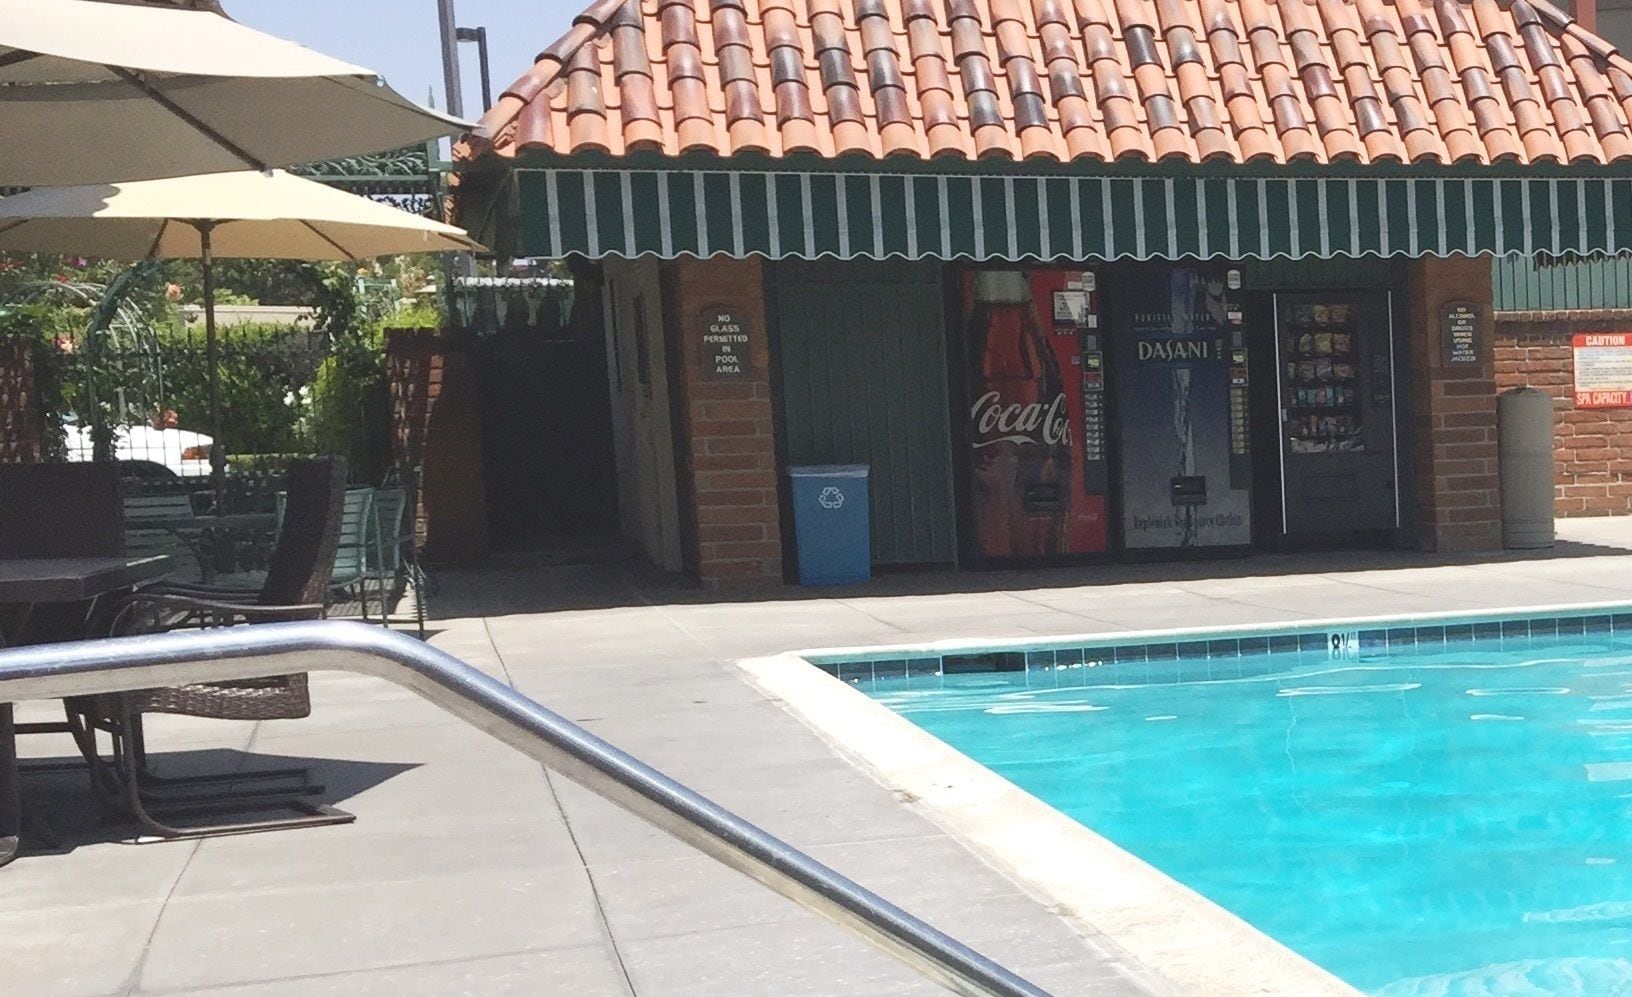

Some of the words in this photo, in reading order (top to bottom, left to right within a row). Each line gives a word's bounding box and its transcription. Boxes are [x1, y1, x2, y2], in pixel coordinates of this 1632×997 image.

[717, 314, 731, 322] NO
[710, 324, 740, 332] GLASS
[703, 334, 748, 342] PERMITTED
[1585, 335, 1626, 346] CAUTION
[1138, 339, 1208, 361] DASANI
[715, 355, 739, 363] POOL
[716, 365, 740, 373] AREA
[1577, 391, 1591, 405] SPA
[1593, 391, 1628, 405] CAPACITY
[970, 390, 1073, 448] Coca-Col
